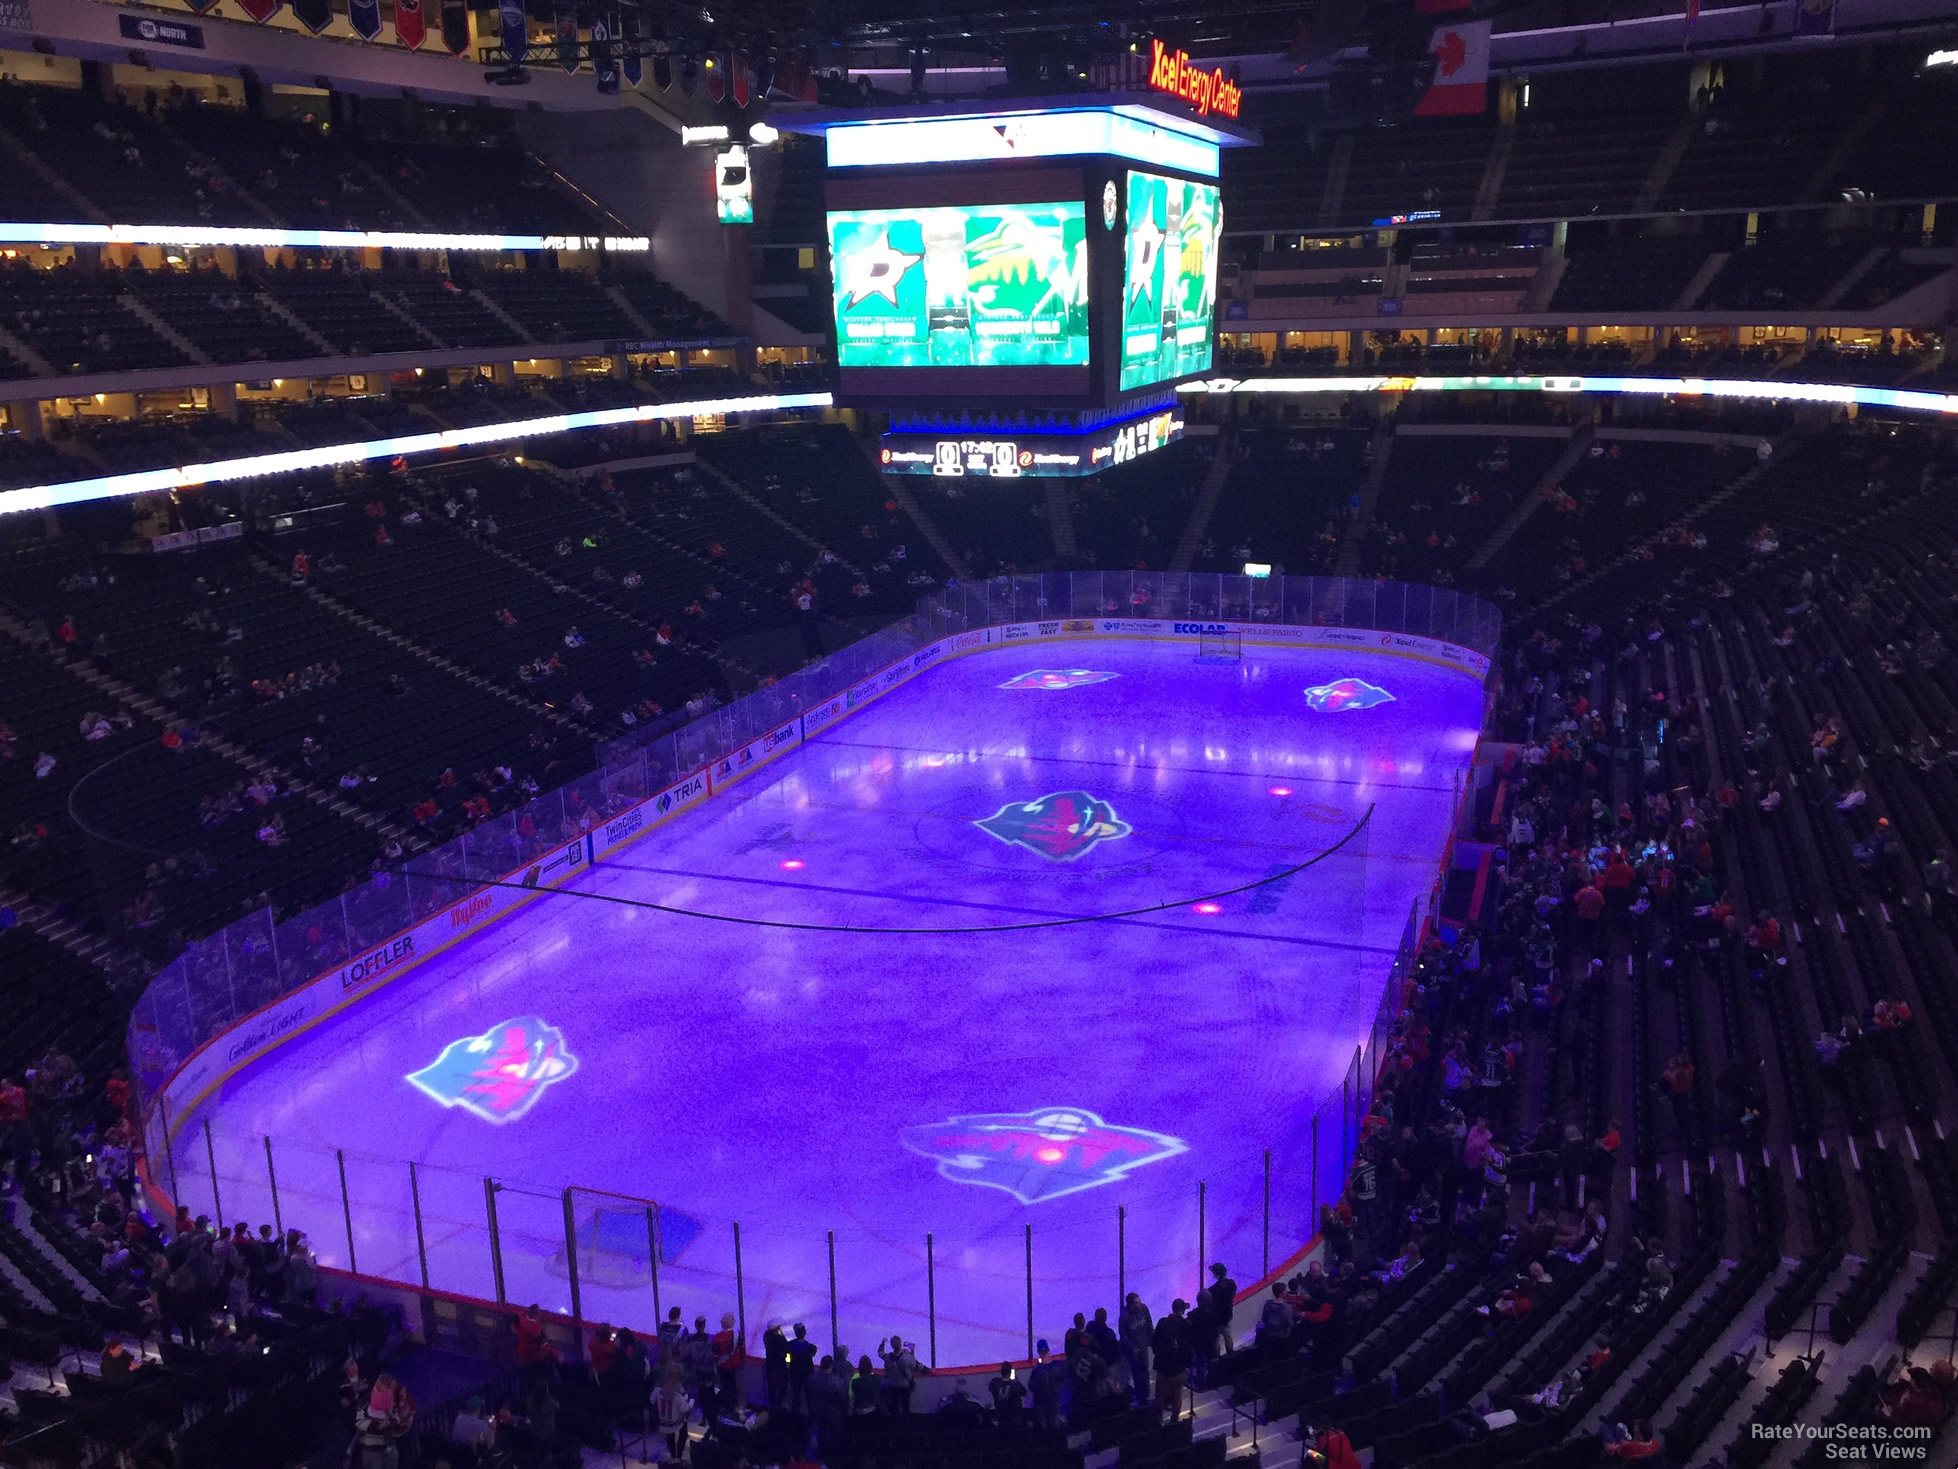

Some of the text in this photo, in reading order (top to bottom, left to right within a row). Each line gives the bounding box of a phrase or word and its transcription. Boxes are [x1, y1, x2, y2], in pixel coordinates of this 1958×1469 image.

[159, 26, 186, 40] NORTH
[1150, 38, 1241, 117] Xcel Energy Center
[640, 341, 665, 349] Wealth
[666, 339, 710, 348] Management
[1238, 627, 1303, 637] WELLS FARGO
[673, 778, 702, 802] TRIA
[340, 936, 414, 989] LOFFLER
[270, 1006, 305, 1037] LIGHT
[1364, 1175, 1376, 1191] 16
